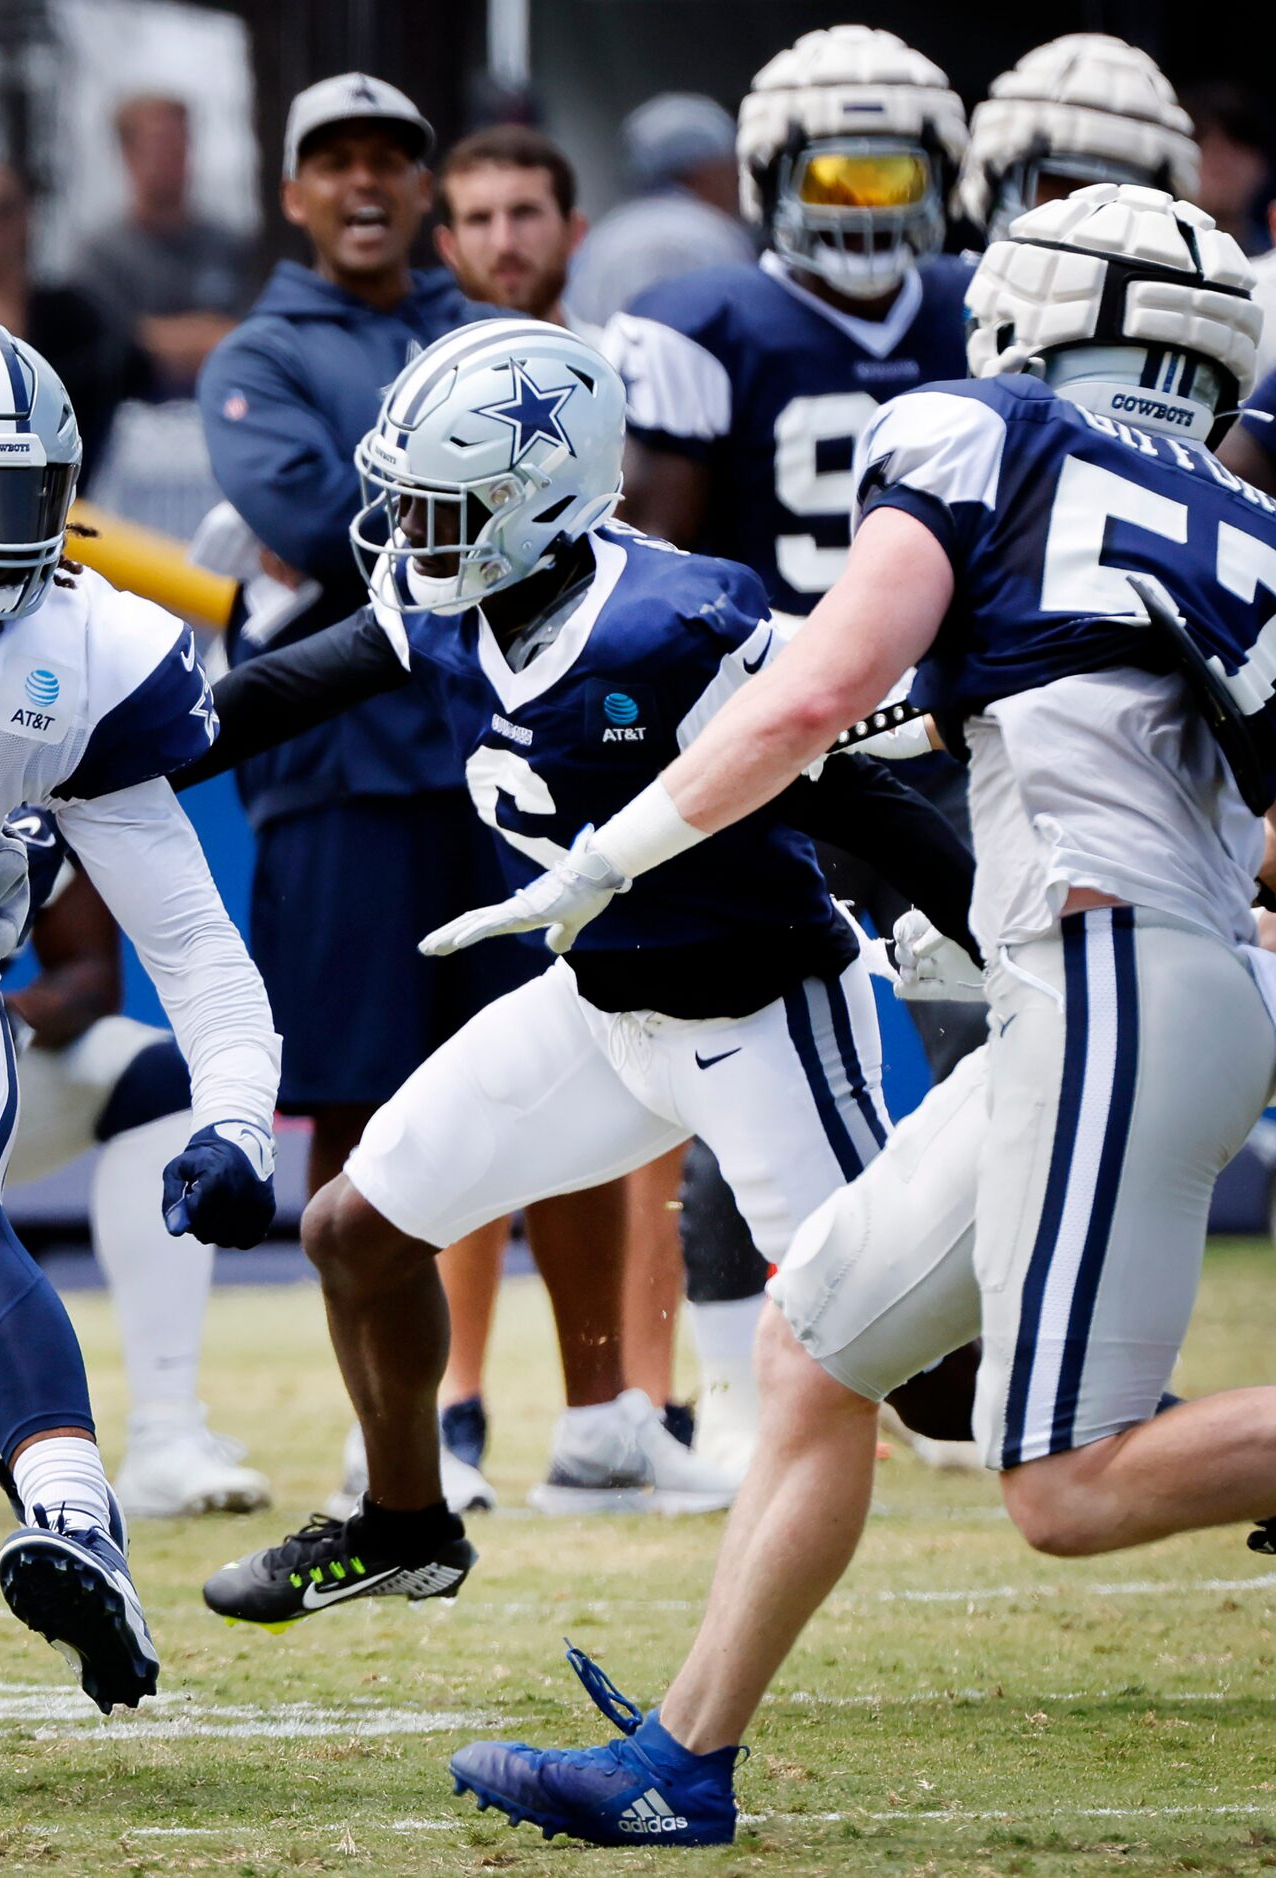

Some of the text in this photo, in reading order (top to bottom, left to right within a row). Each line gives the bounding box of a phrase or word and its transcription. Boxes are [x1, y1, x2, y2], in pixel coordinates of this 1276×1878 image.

[1111, 393, 1195, 427] COWBOYS
[10, 708, 56, 732] AT&T
[602, 727, 647, 742] AT&T
[618, 1814, 689, 1833] adidas
